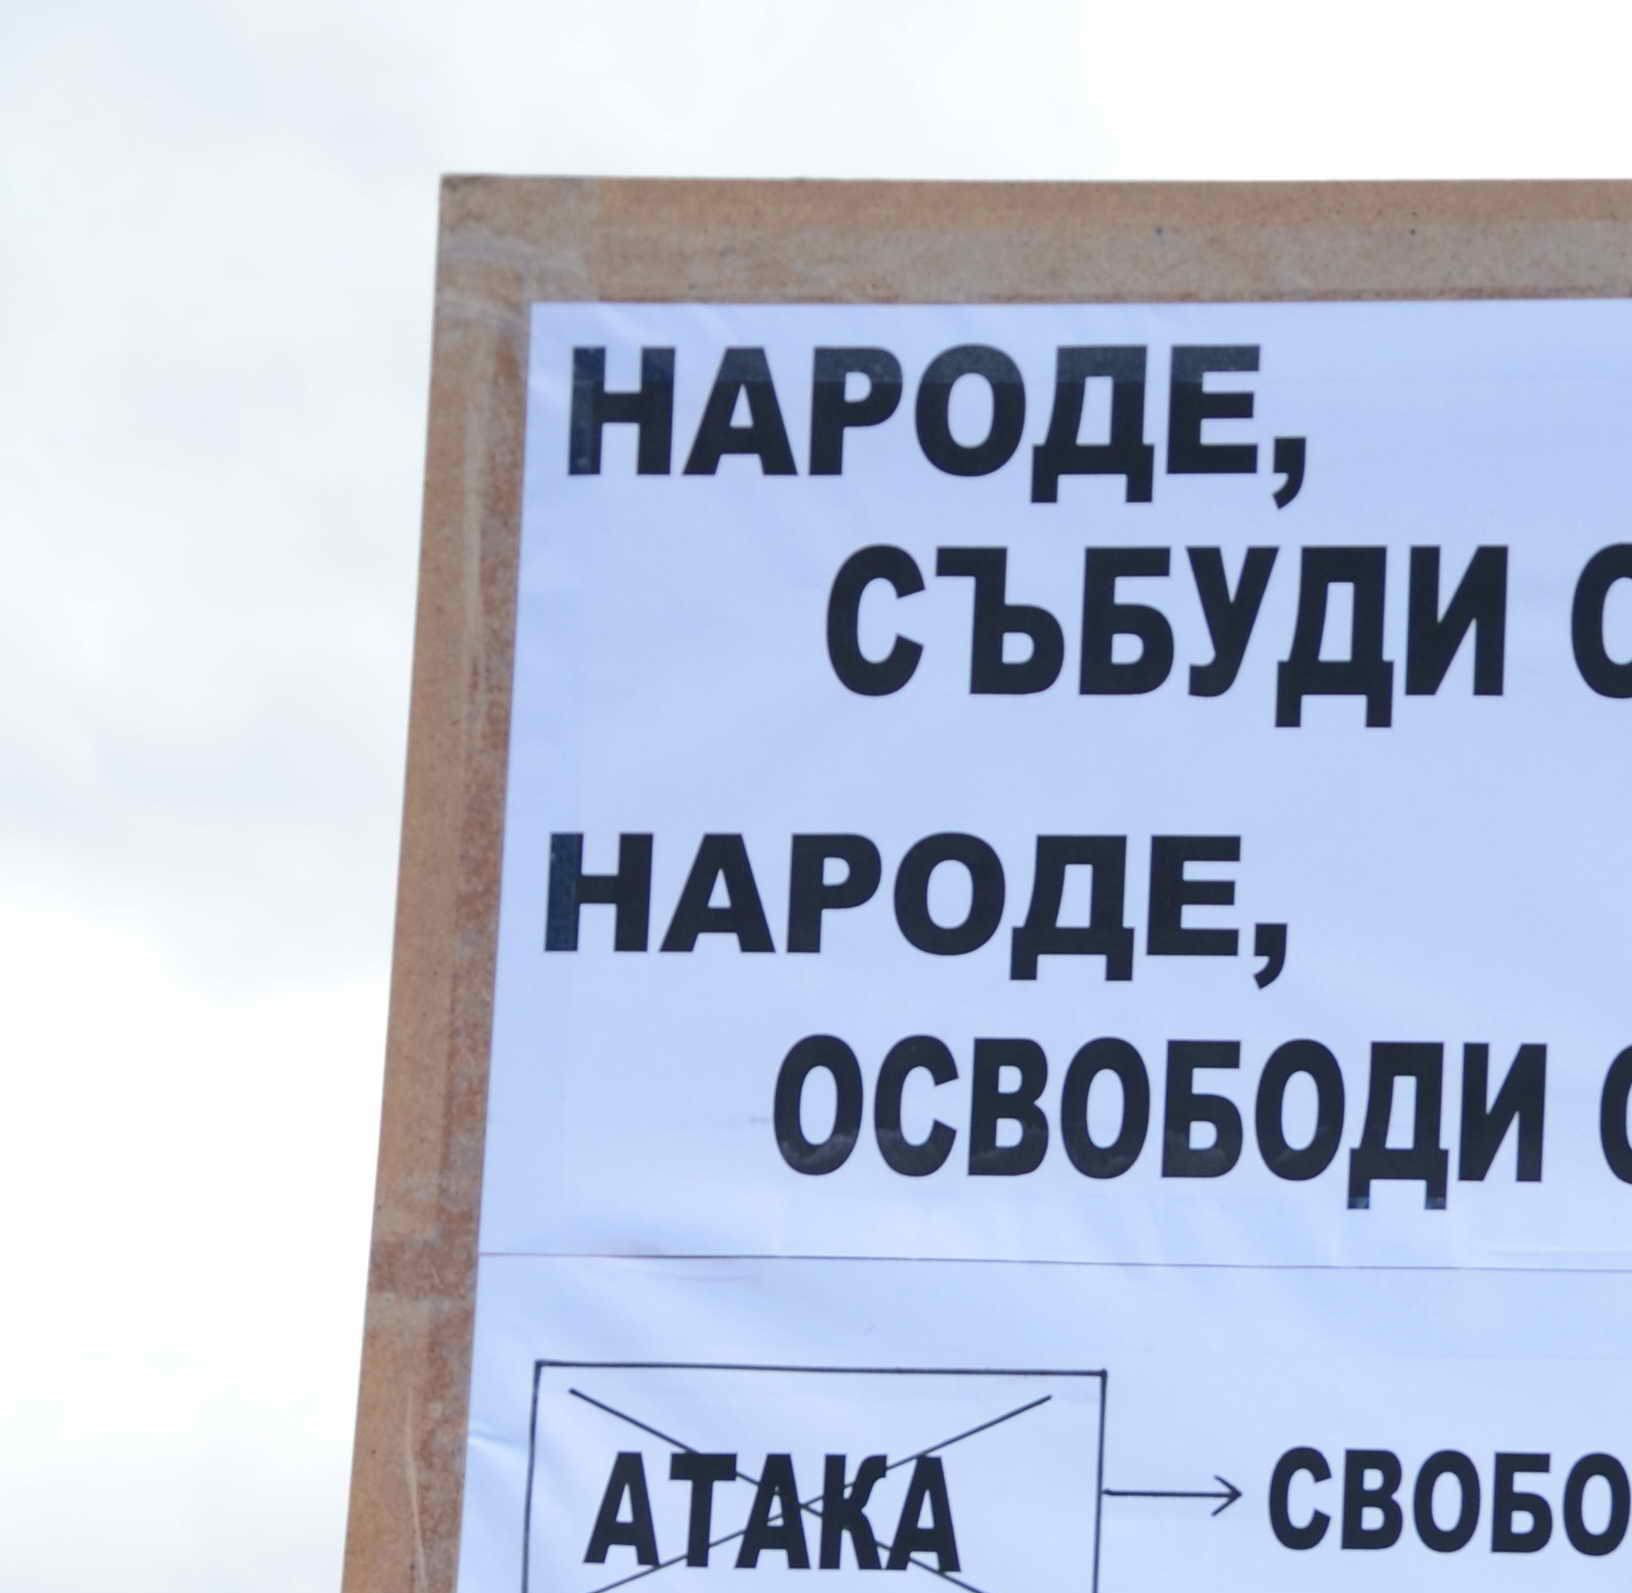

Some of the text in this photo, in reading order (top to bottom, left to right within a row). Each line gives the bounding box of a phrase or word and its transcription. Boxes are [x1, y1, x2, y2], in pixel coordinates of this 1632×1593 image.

[568, 345, 1307, 510] НАРОДЕ,
[826, 543, 1509, 728] СЪБУДИ
[544, 832, 1288, 989] НАРОДЕ,
[773, 1034, 1547, 1210] ОСВОБОДИ
[584, 1450, 961, 1574] АТАКА
